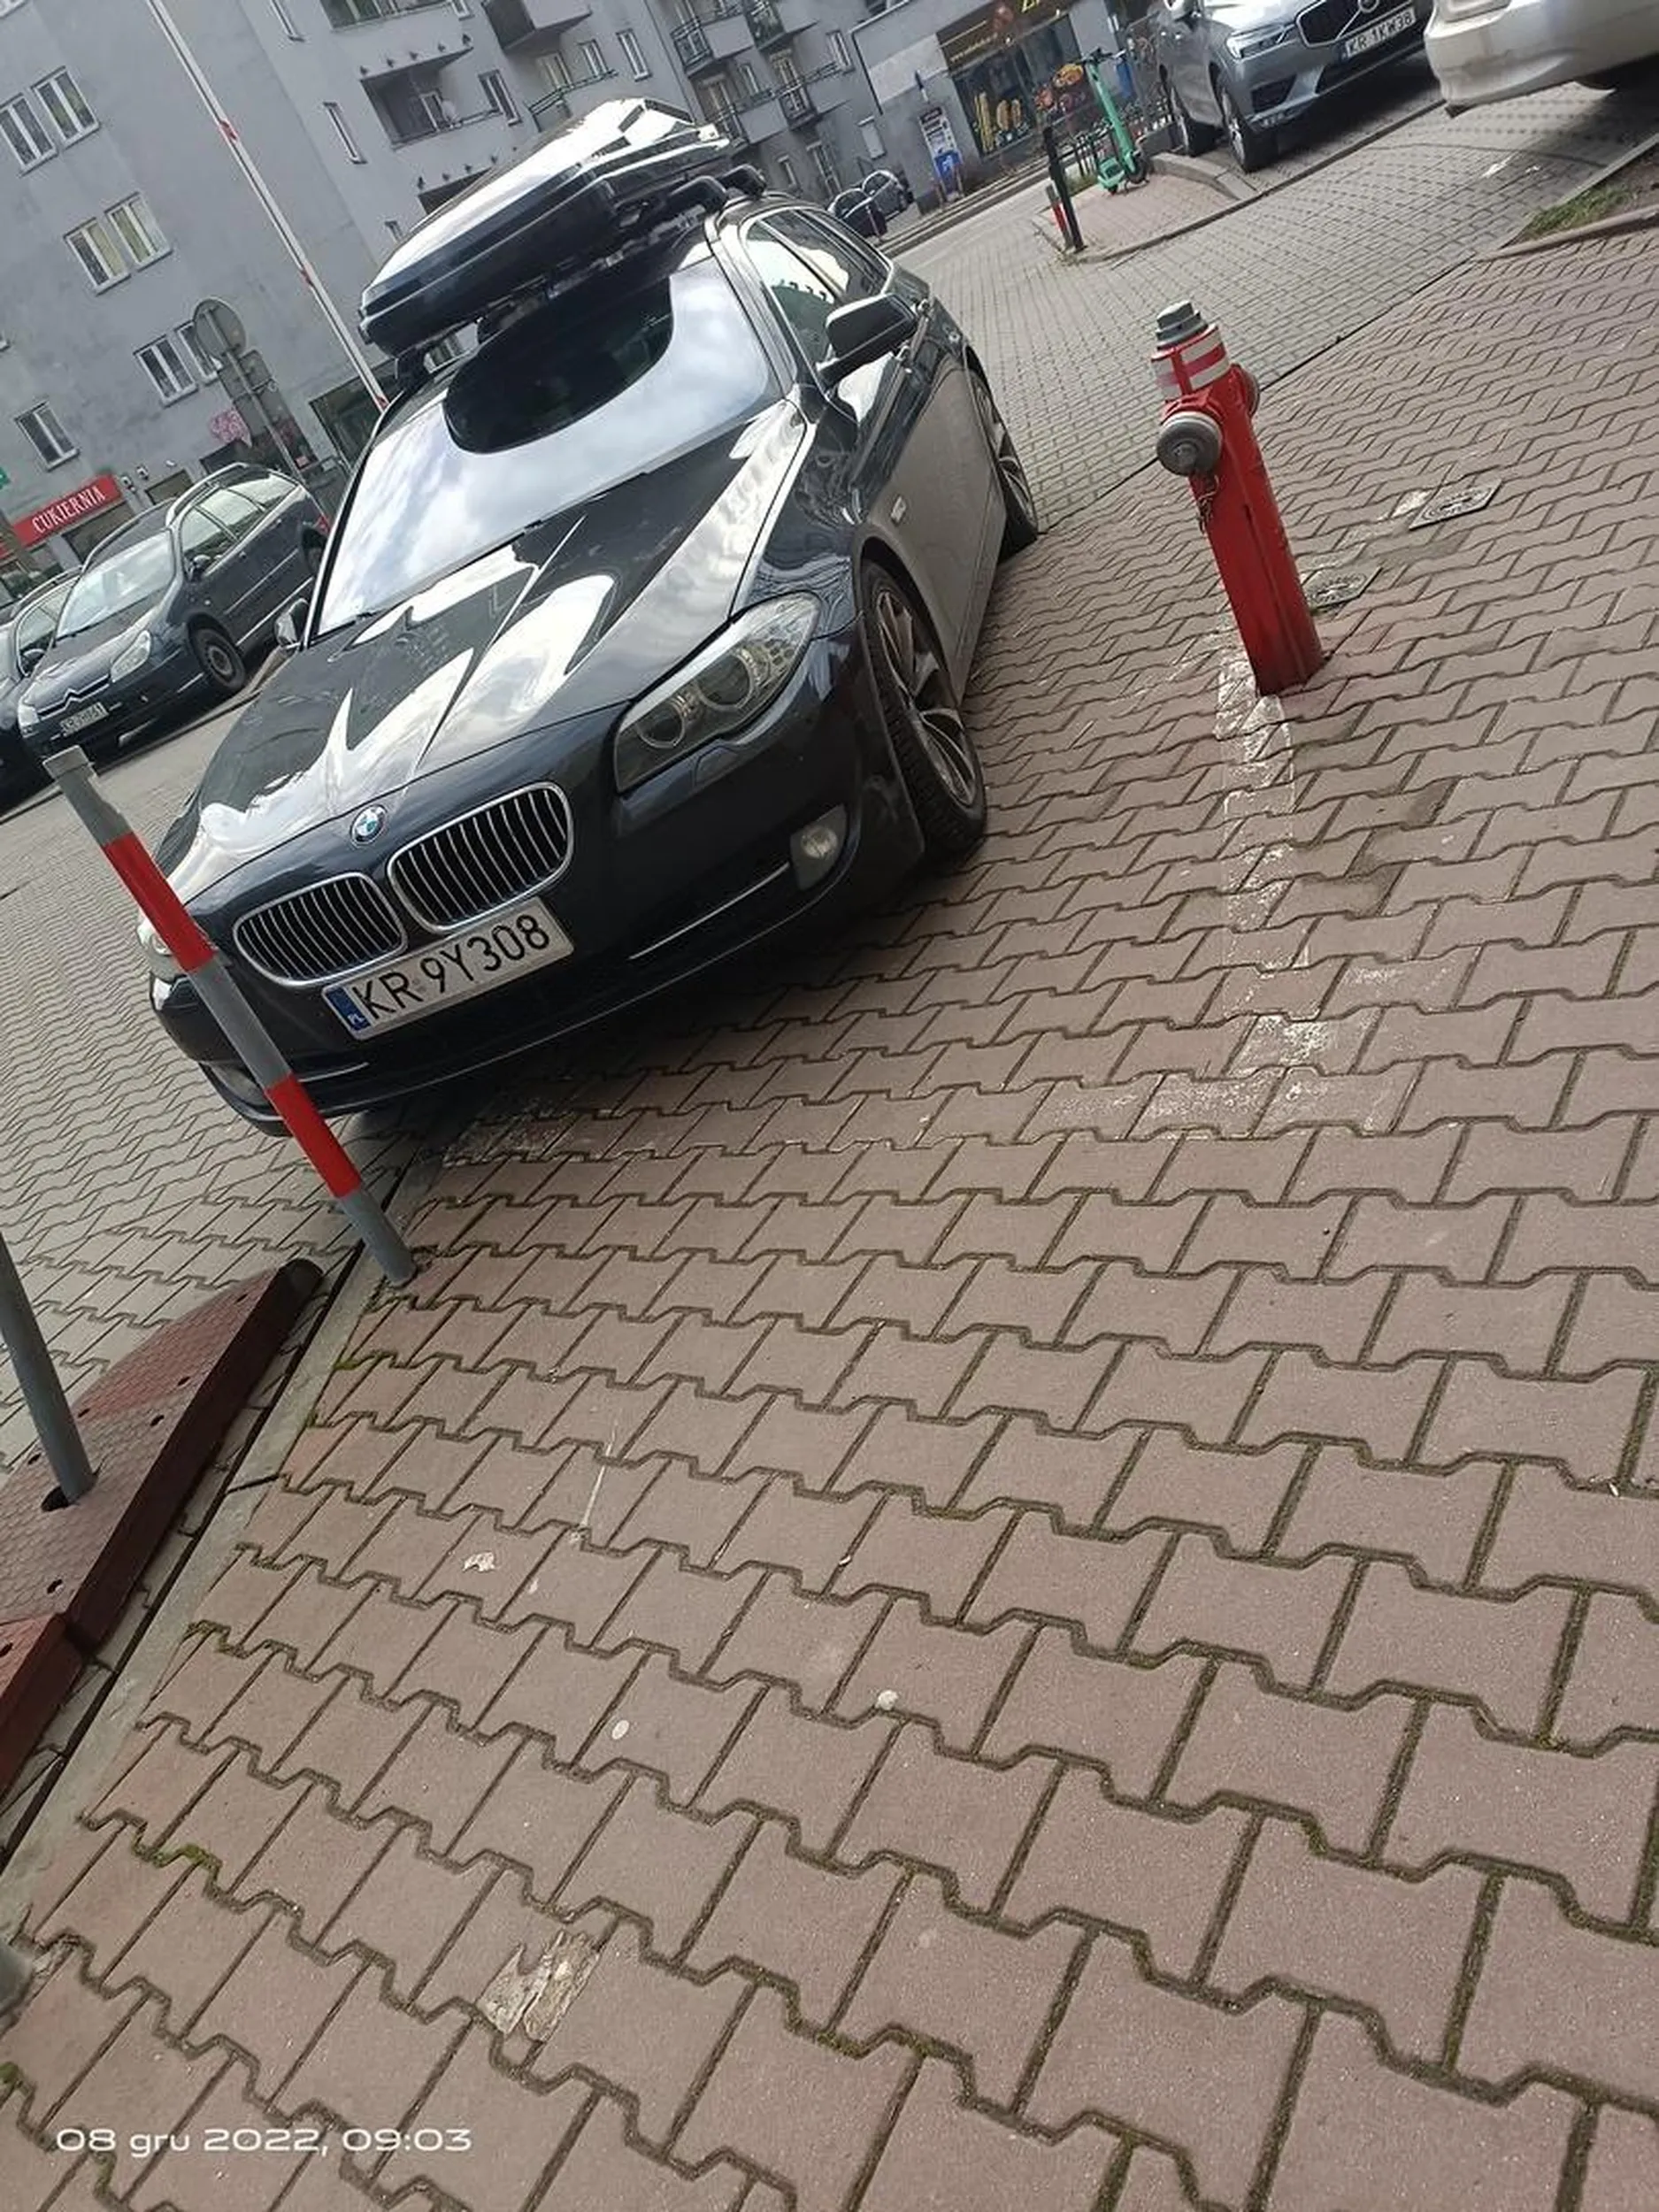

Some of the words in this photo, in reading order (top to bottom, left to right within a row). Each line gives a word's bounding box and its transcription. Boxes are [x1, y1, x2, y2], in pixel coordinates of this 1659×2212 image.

[32, 485, 106, 534] CUKIERNIA
[352, 973, 423, 1019] KR
[419, 914, 549, 993] 9Y308
